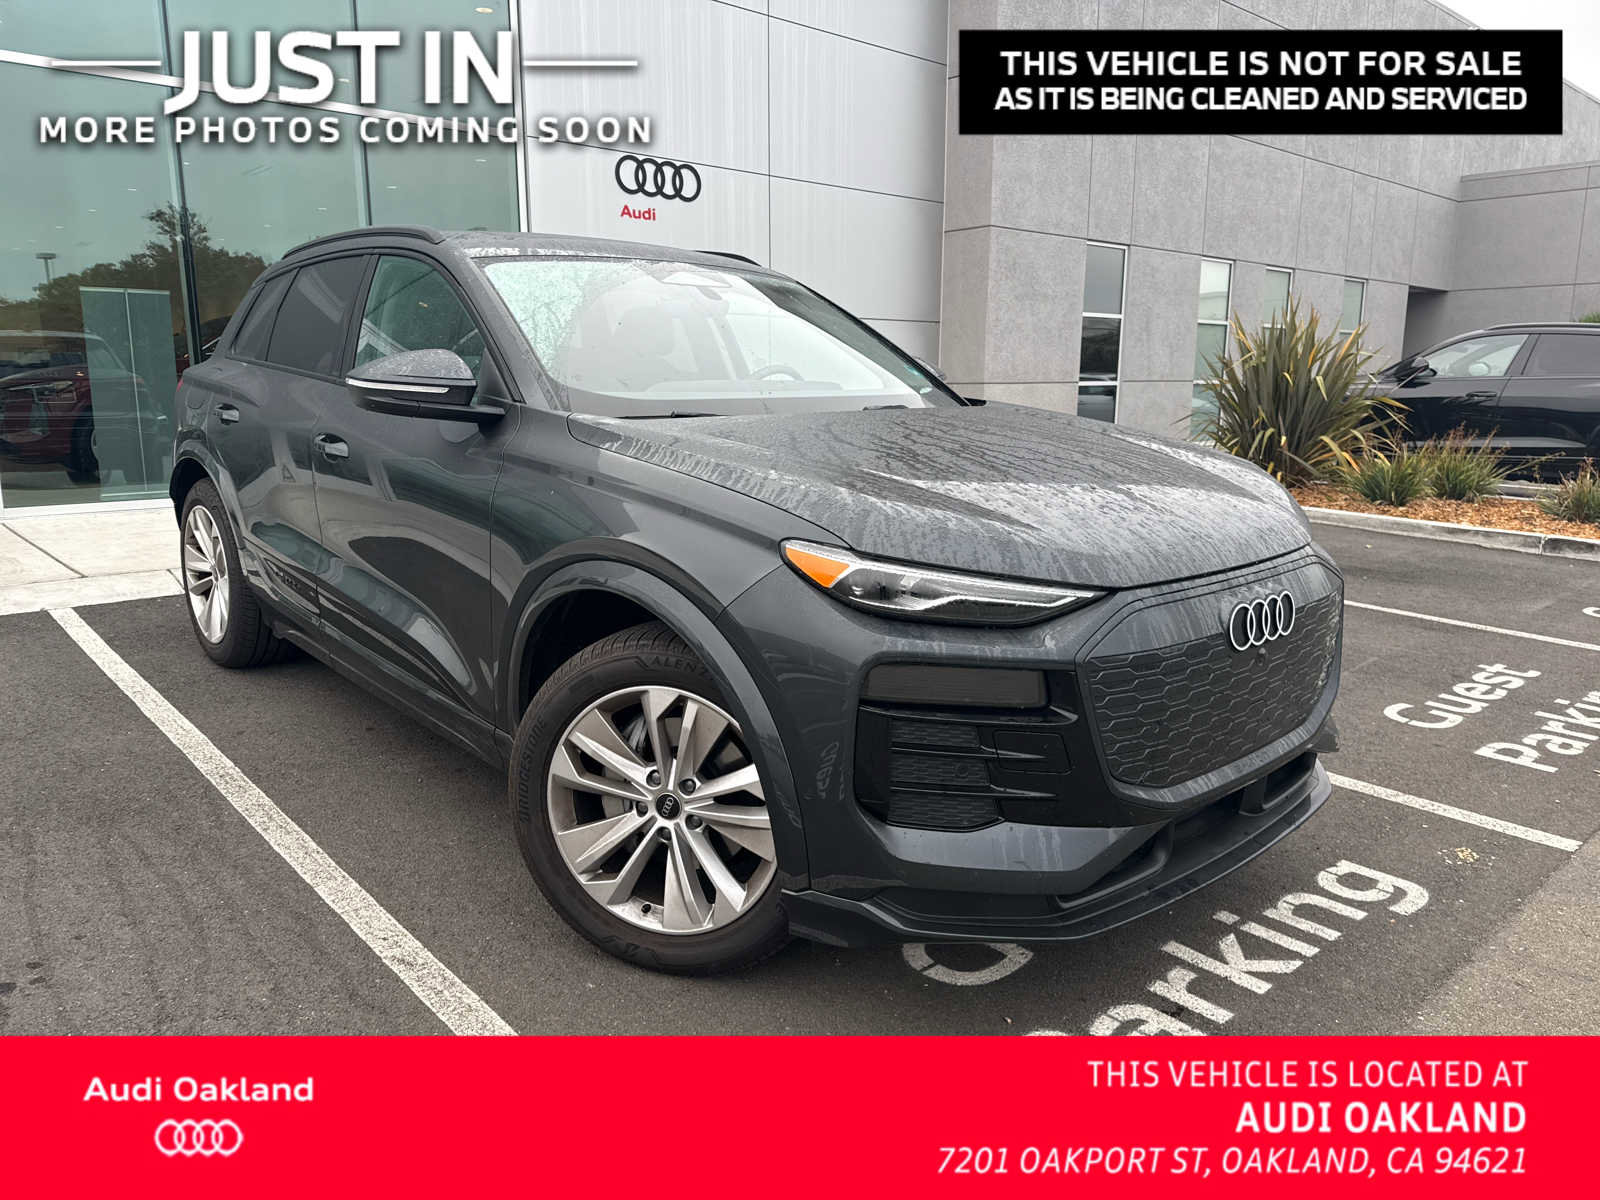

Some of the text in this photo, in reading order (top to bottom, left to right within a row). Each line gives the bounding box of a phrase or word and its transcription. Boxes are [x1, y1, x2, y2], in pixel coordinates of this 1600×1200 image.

[621, 204, 656, 221] Audi
[1383, 663, 1542, 729] Guest
[1023, 860, 1430, 1036] arking
